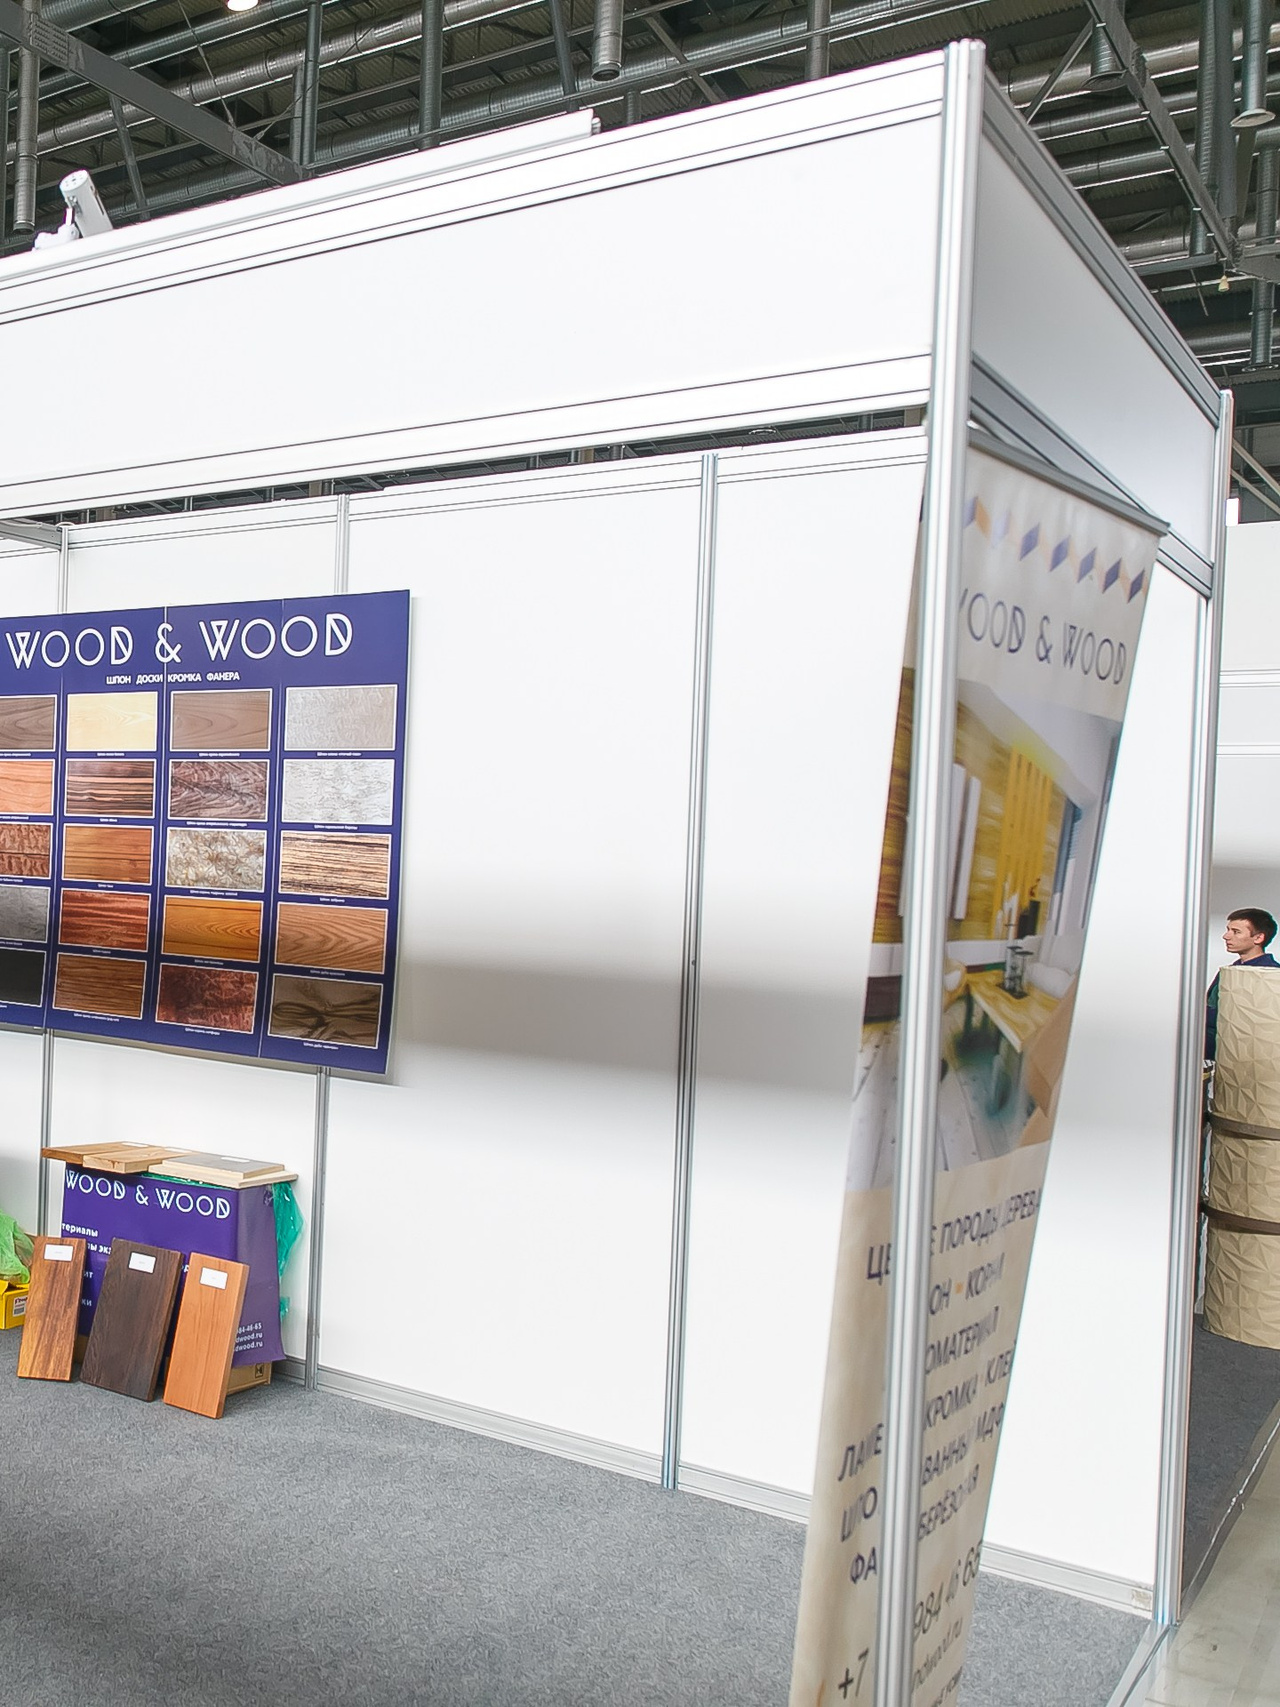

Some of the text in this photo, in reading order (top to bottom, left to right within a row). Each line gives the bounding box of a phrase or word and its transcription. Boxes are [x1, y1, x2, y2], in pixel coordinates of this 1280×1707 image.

[5, 613, 354, 670] WOOD & WOOD
[959, 588, 1127, 685] OOD & WOOD
[106, 671, 240, 685] ШПОН ДОСКИ КРОМКА ФАНЕРА
[66, 1170, 231, 1219] WOOD & WOOD
